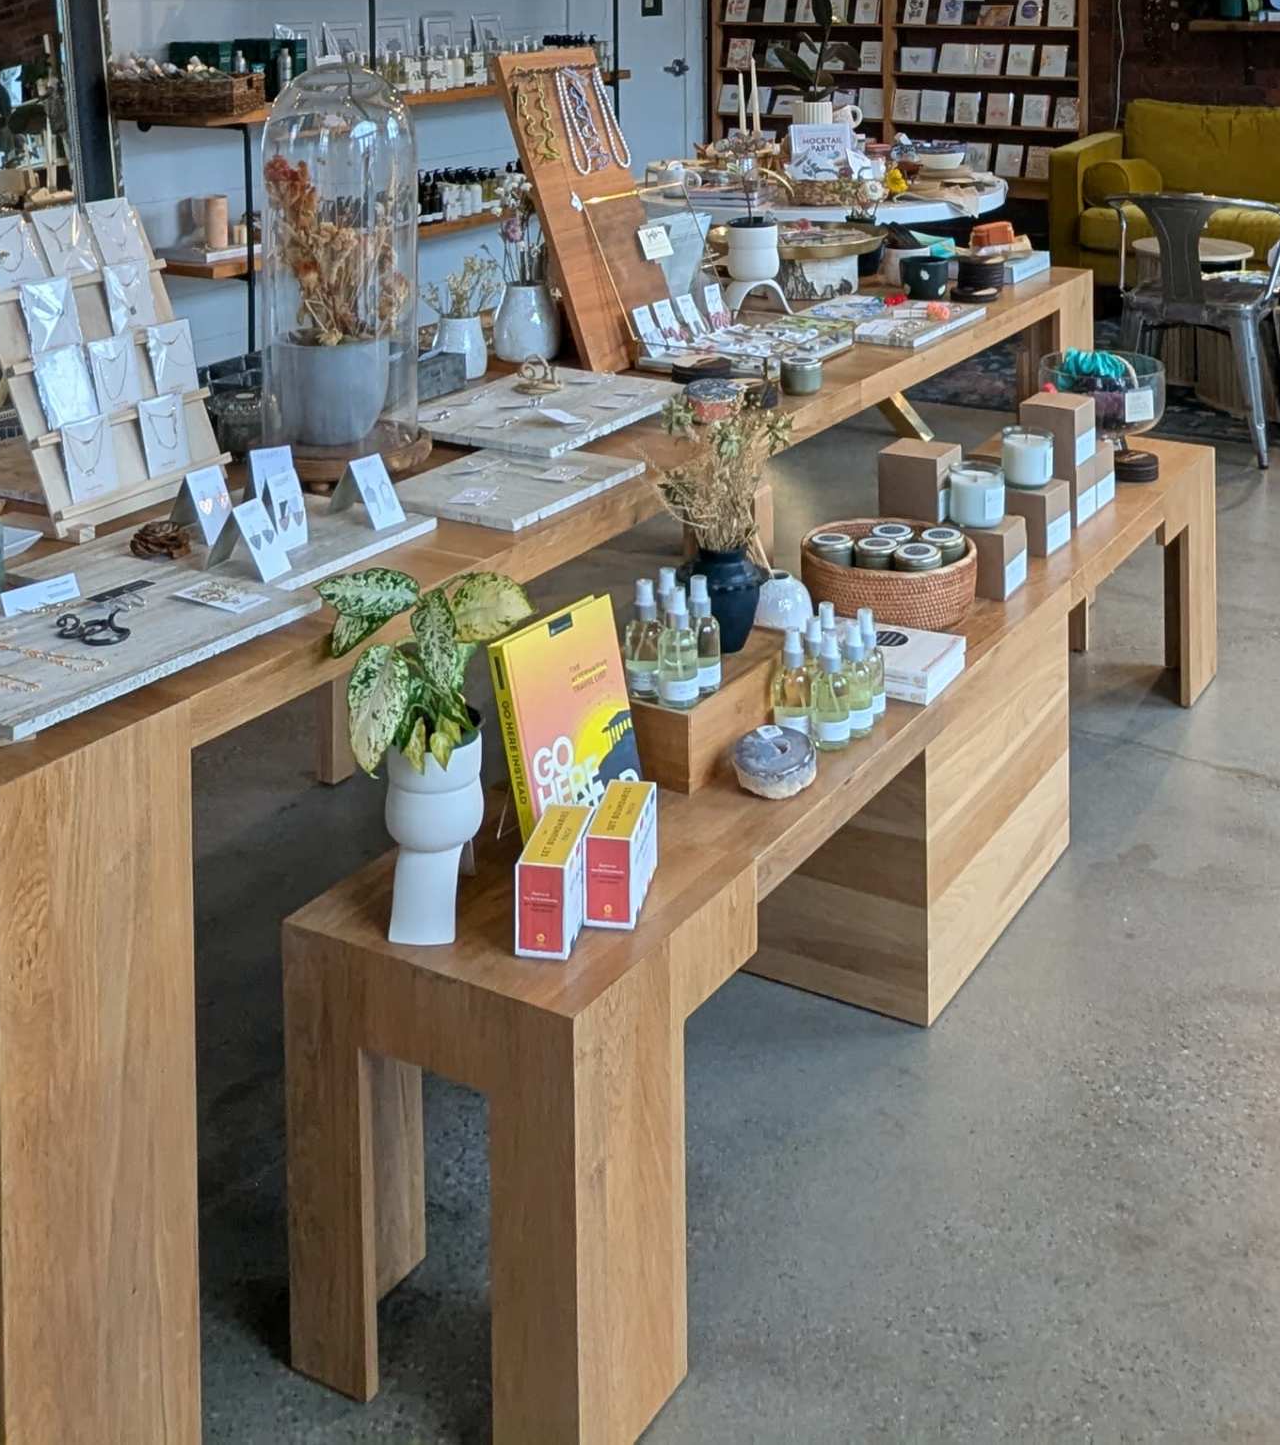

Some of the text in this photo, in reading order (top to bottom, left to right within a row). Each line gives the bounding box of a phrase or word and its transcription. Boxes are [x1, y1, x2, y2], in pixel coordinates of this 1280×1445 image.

[810, 144, 836, 153] PARTY
[501, 700, 528, 805] GO HERE INSTEAD
[533, 735, 574, 787] GO
